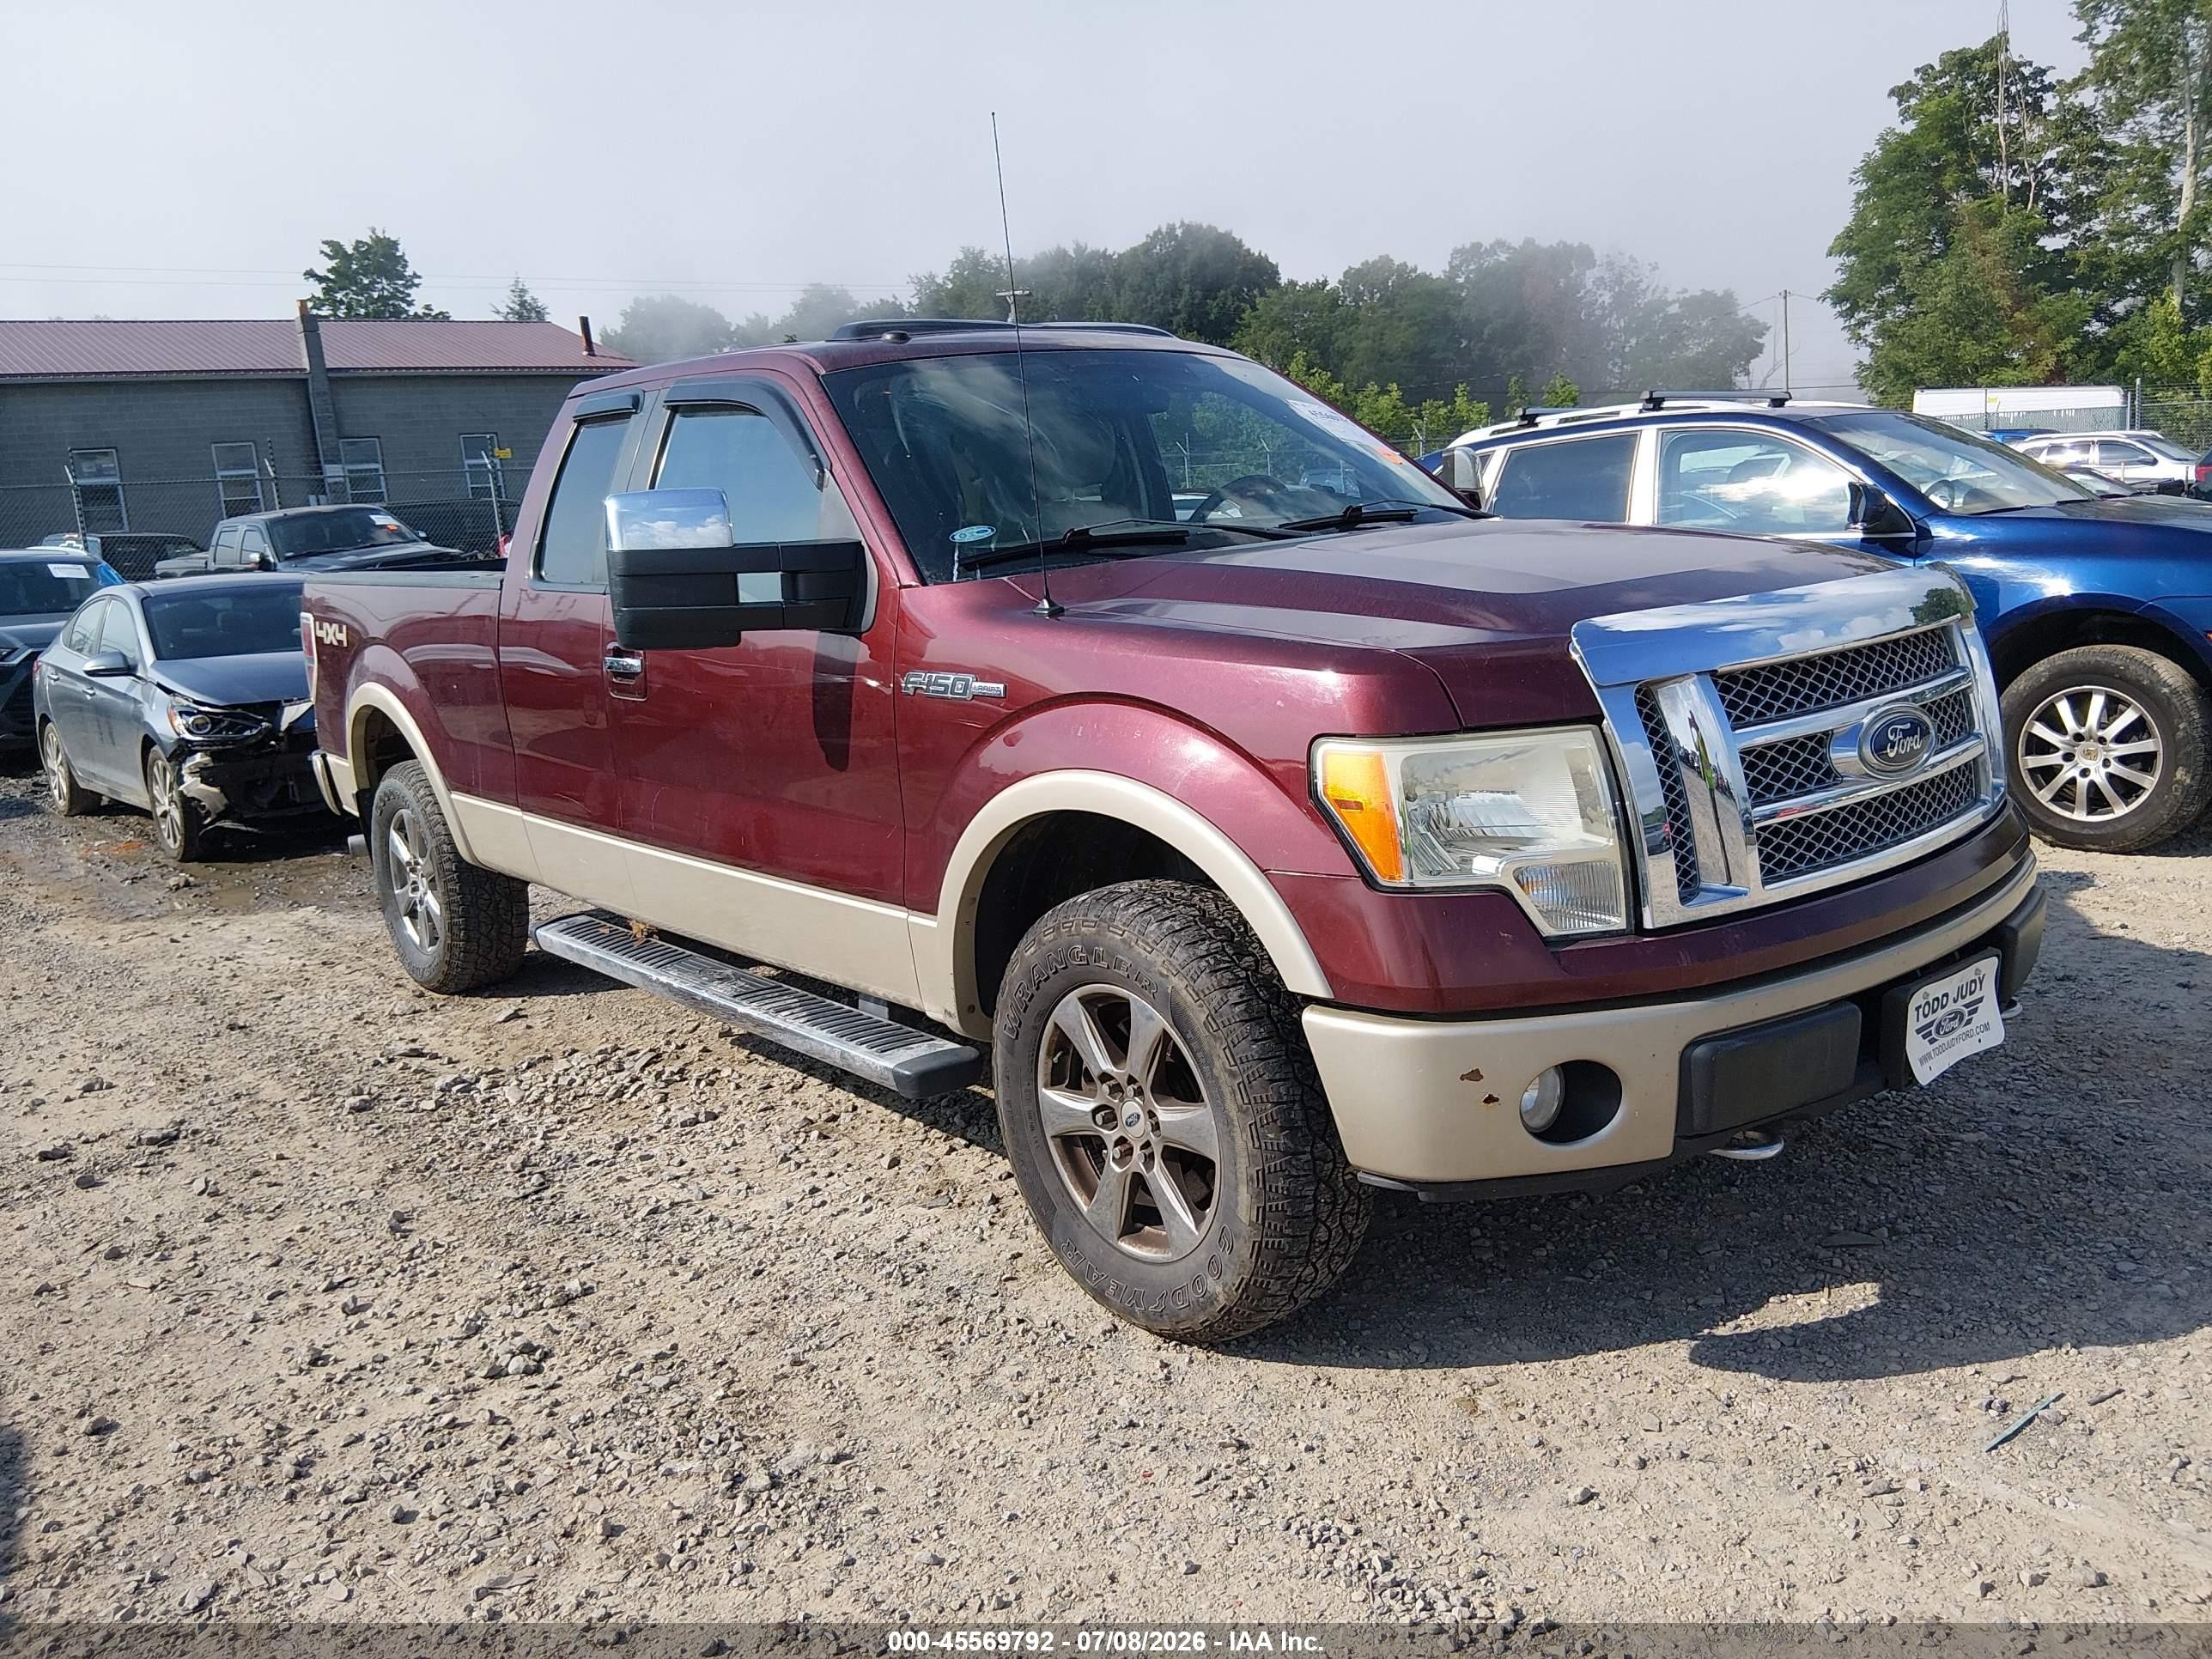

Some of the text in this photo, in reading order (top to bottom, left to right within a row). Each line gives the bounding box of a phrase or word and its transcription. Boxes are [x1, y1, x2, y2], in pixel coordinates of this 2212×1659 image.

[1887, 722, 1923, 757] Ford
[1004, 945, 1158, 1040] WRANGLER
[1914, 973, 1986, 1023] TODD JUDY
[1918, 1021, 1991, 1066] WWW.TODDJUDYFORD.COM
[1939, 1014, 1960, 1036] Ford
[1060, 1224, 1234, 1312] GOODYEAR
